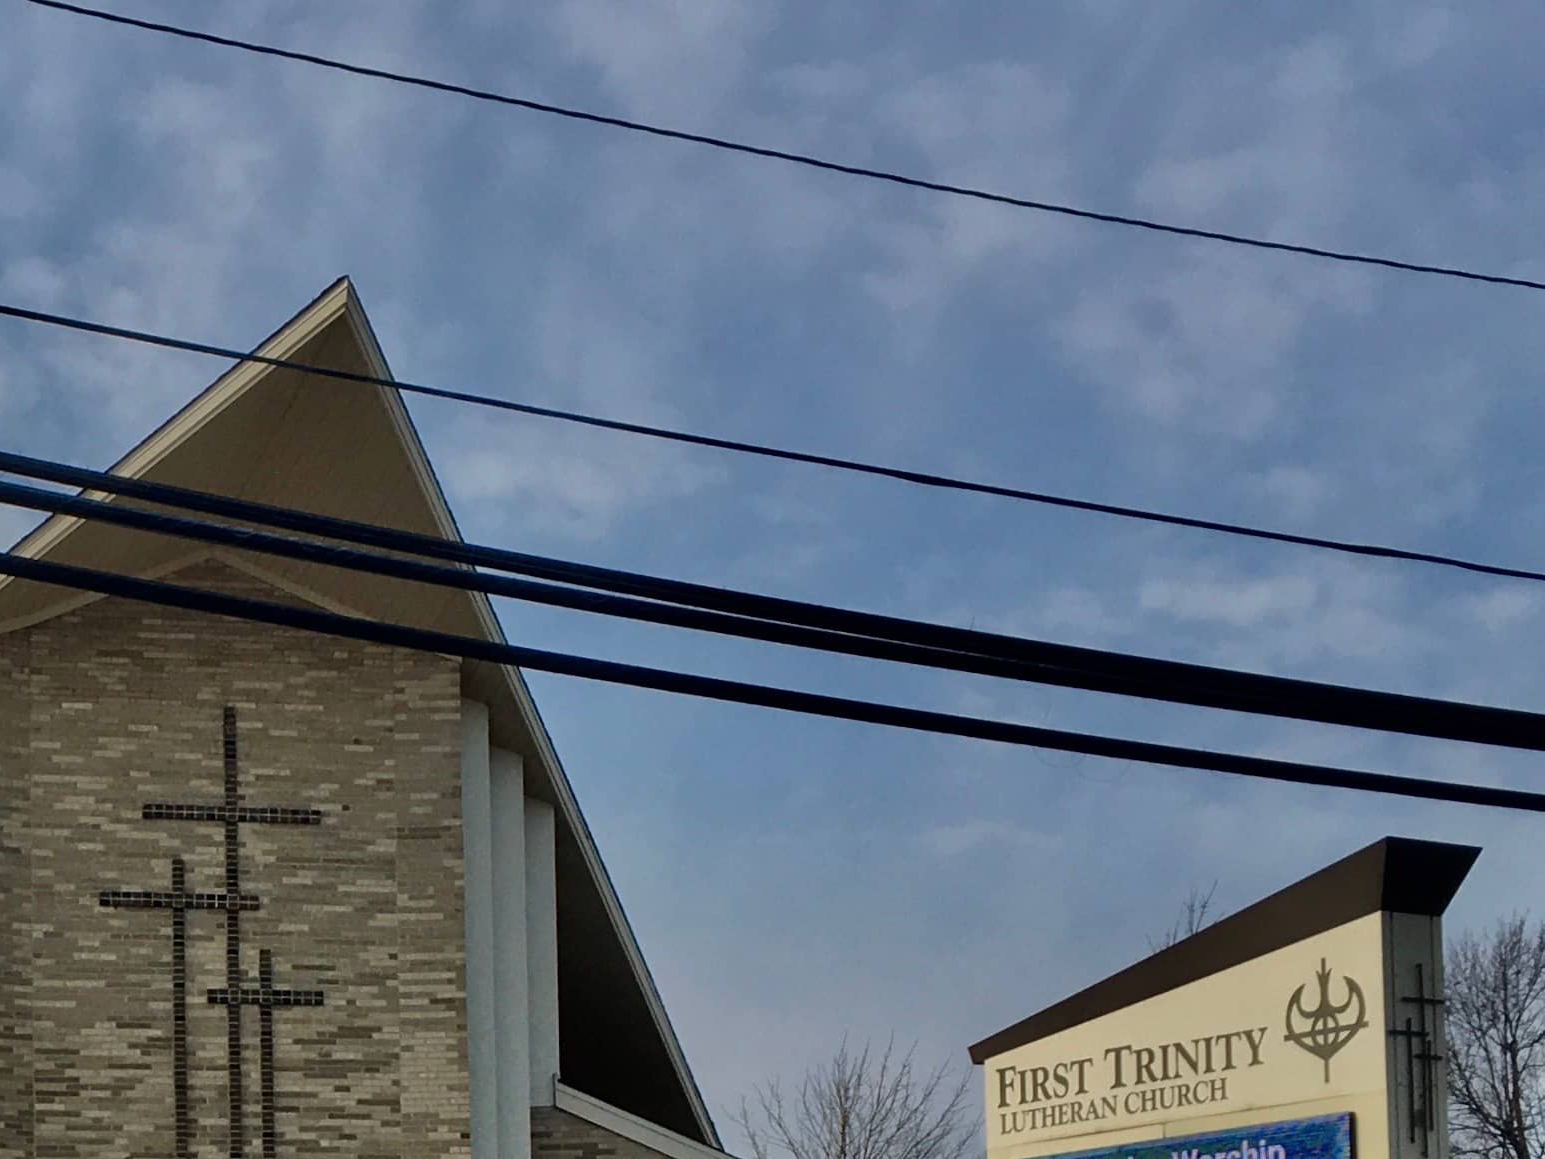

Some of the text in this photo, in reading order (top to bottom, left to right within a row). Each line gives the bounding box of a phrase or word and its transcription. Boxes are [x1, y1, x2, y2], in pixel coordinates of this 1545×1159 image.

[995, 1026, 1268, 1109] FIRST TRINITY
[1000, 1077, 1229, 1136] LUTHERAN CHURCH
